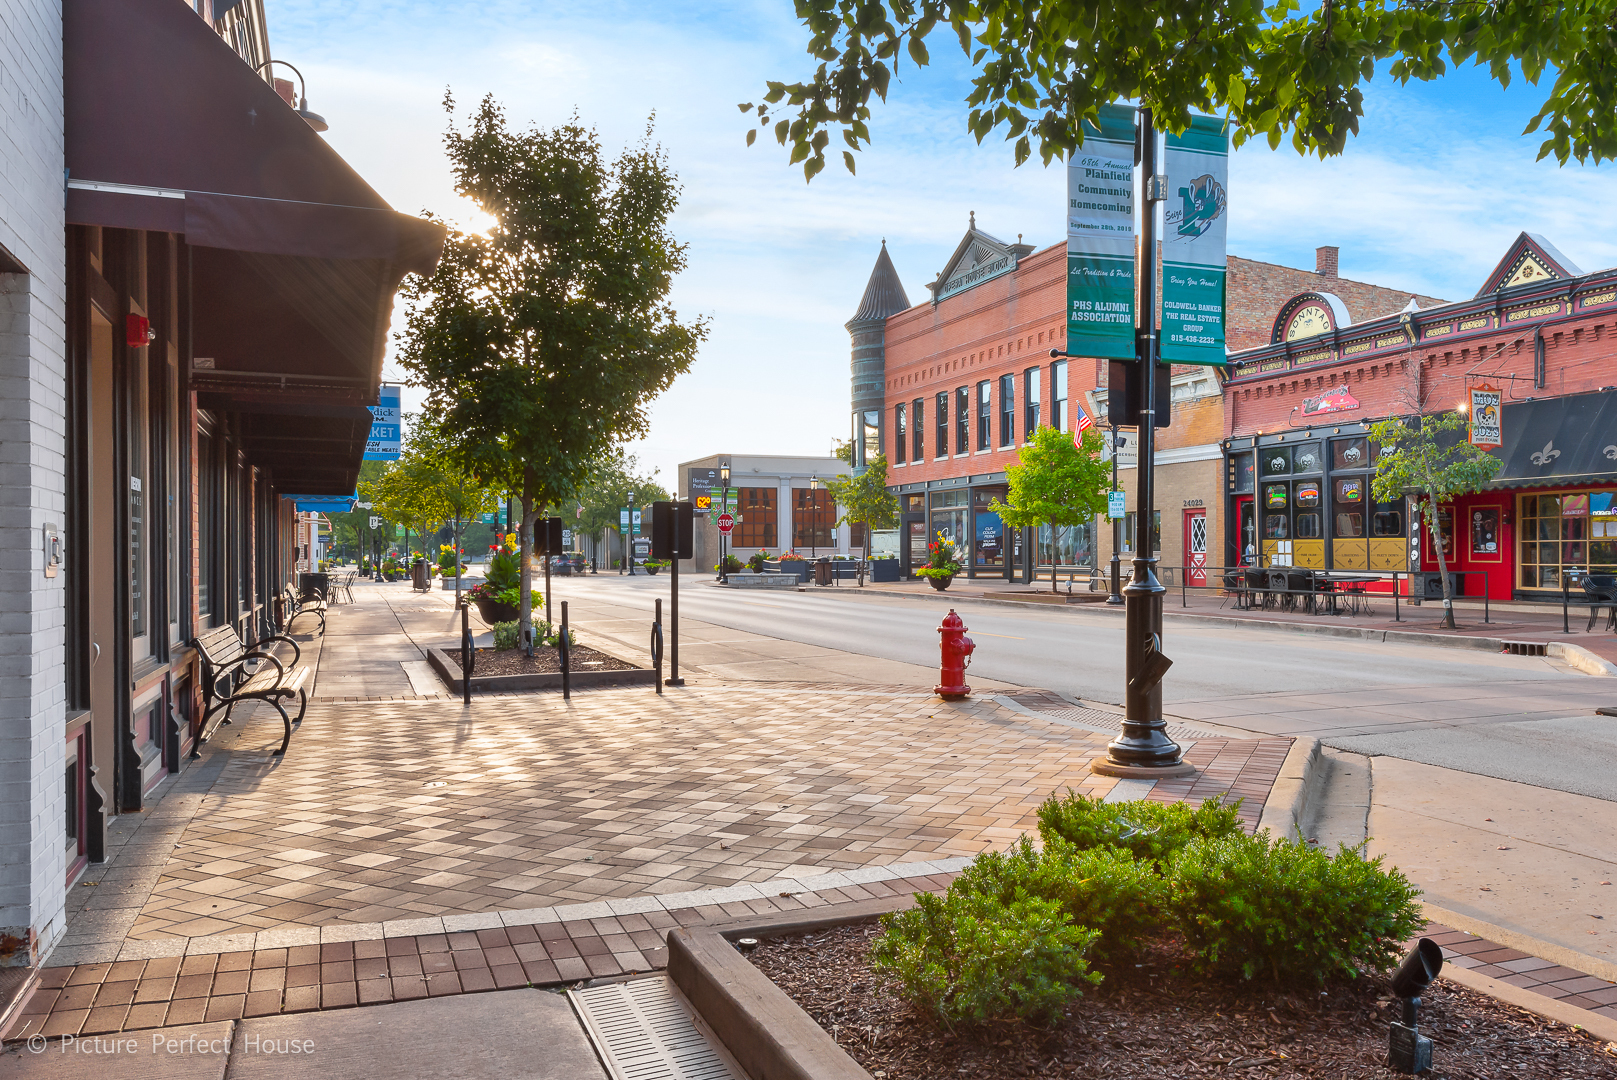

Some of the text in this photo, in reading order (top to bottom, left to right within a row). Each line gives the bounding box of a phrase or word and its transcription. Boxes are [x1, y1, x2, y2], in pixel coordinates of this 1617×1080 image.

[1081, 157, 1132, 170] 68th Annual
[1085, 168, 1131, 182] Plainfield
[1078, 183, 1131, 199] Community
[1070, 198, 1132, 215] Homecoming
[1165, 209, 1183, 221] Seize
[1070, 222, 1100, 230] September
[943, 256, 1009, 293] OPERA HOUSE BLOCK
[1070, 266, 1132, 278] Let Tradition & Pride
[1170, 275, 1218, 287] Bring You Home!
[1073, 300, 1130, 312] PHS ALUMNI
[1164, 301, 1222, 313] COLDWELL BANKER
[1071, 311, 1131, 324] ASSOCIATION
[1165, 312, 1220, 323] THE REAL ESTATE
[1289, 307, 1330, 338] SONNTAG
[1183, 324, 1204, 332] GROUP
[1473, 393, 1499, 406] MOE
[371, 407, 394, 417] dick
[369, 426, 394, 438] KET
[1473, 425, 1499, 437] JOE'S
[1109, 493, 1114, 501] 3
[1183, 498, 1203, 507] 24023
